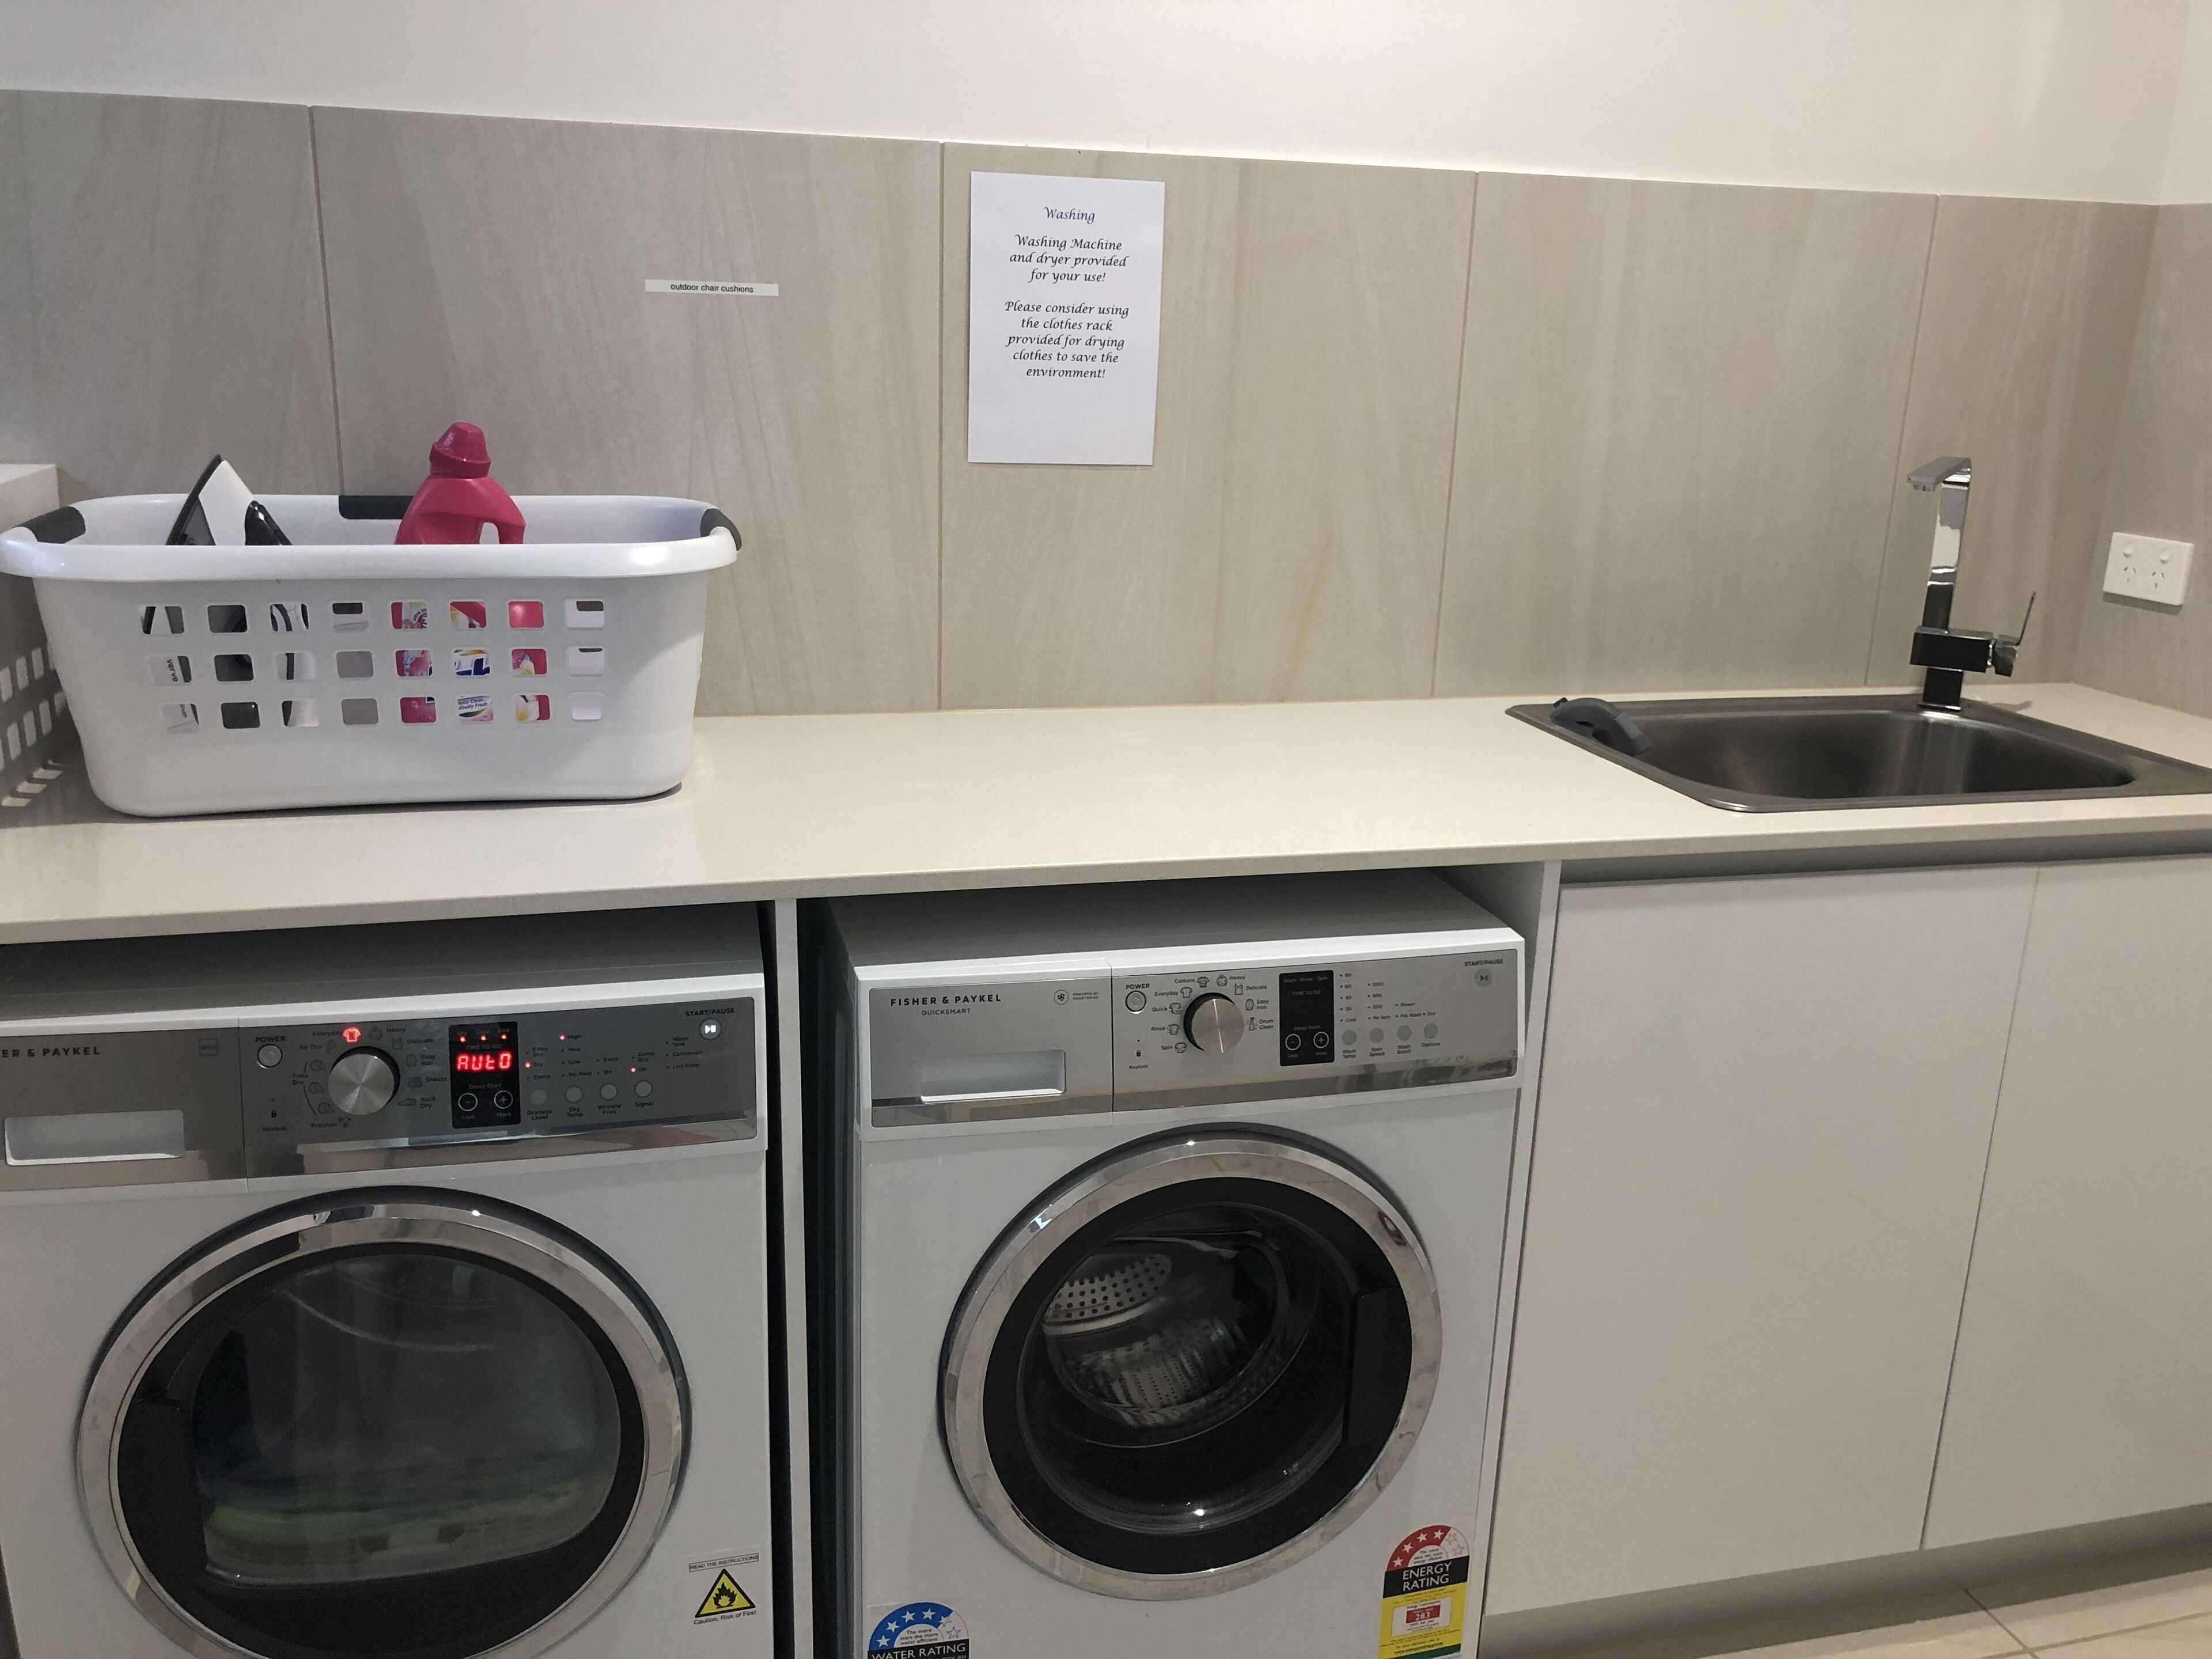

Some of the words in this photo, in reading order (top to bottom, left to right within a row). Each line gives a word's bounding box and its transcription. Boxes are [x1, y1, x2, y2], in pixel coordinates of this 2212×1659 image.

[1044, 207, 1094, 224] Washing
[1015, 234, 1067, 251] Washing
[1070, 238, 1122, 250] Machine
[1010, 252, 1035, 263] and
[1036, 252, 1070, 267] dryer
[1071, 255, 1129, 268] provided
[1028, 268, 1048, 283] for
[1052, 273, 1080, 284] your
[1084, 272, 1105, 282] use!
[700, 284, 719, 292] chair
[1005, 300, 1041, 312] Please
[1046, 302, 1094, 313] consider
[1098, 305, 1128, 319] using
[1022, 317, 1039, 328] the
[1043, 318, 1082, 329] clothes
[1087, 320, 1112, 331] rack
[1005, 334, 1064, 347] provided
[1062, 335, 1082, 349] for
[1085, 335, 1124, 350] drying
[1013, 349, 1052, 361] clothes
[1057, 352, 1067, 361] to
[1101, 352, 1118, 362] the
[1027, 368, 1105, 378] environment!
[1465, 959, 1503, 967] START/PAUSE
[891, 997, 937, 1007] FISHER
[942, 996, 950, 1004] &
[955, 994, 1002, 1003] PAYKEL
[685, 1007, 735, 1017] START/PAUSE
[921, 1007, 971, 1016] QUICKSMART
[2, 1049, 20, 1058] ER
[27, 1048, 35, 1057] &
[43, 1046, 101, 1056] PAYKEL
[718, 1555, 759, 1565] INSTRUCTIONS
[1403, 1562, 1452, 1581] ENERGY
[1403, 1574, 1449, 1592] RATING
[694, 1617, 719, 1625] Caution,
[1415, 1612, 1431, 1621] 283
[872, 1650, 914, 1659] WATER
[919, 1643, 965, 1657] RATING
